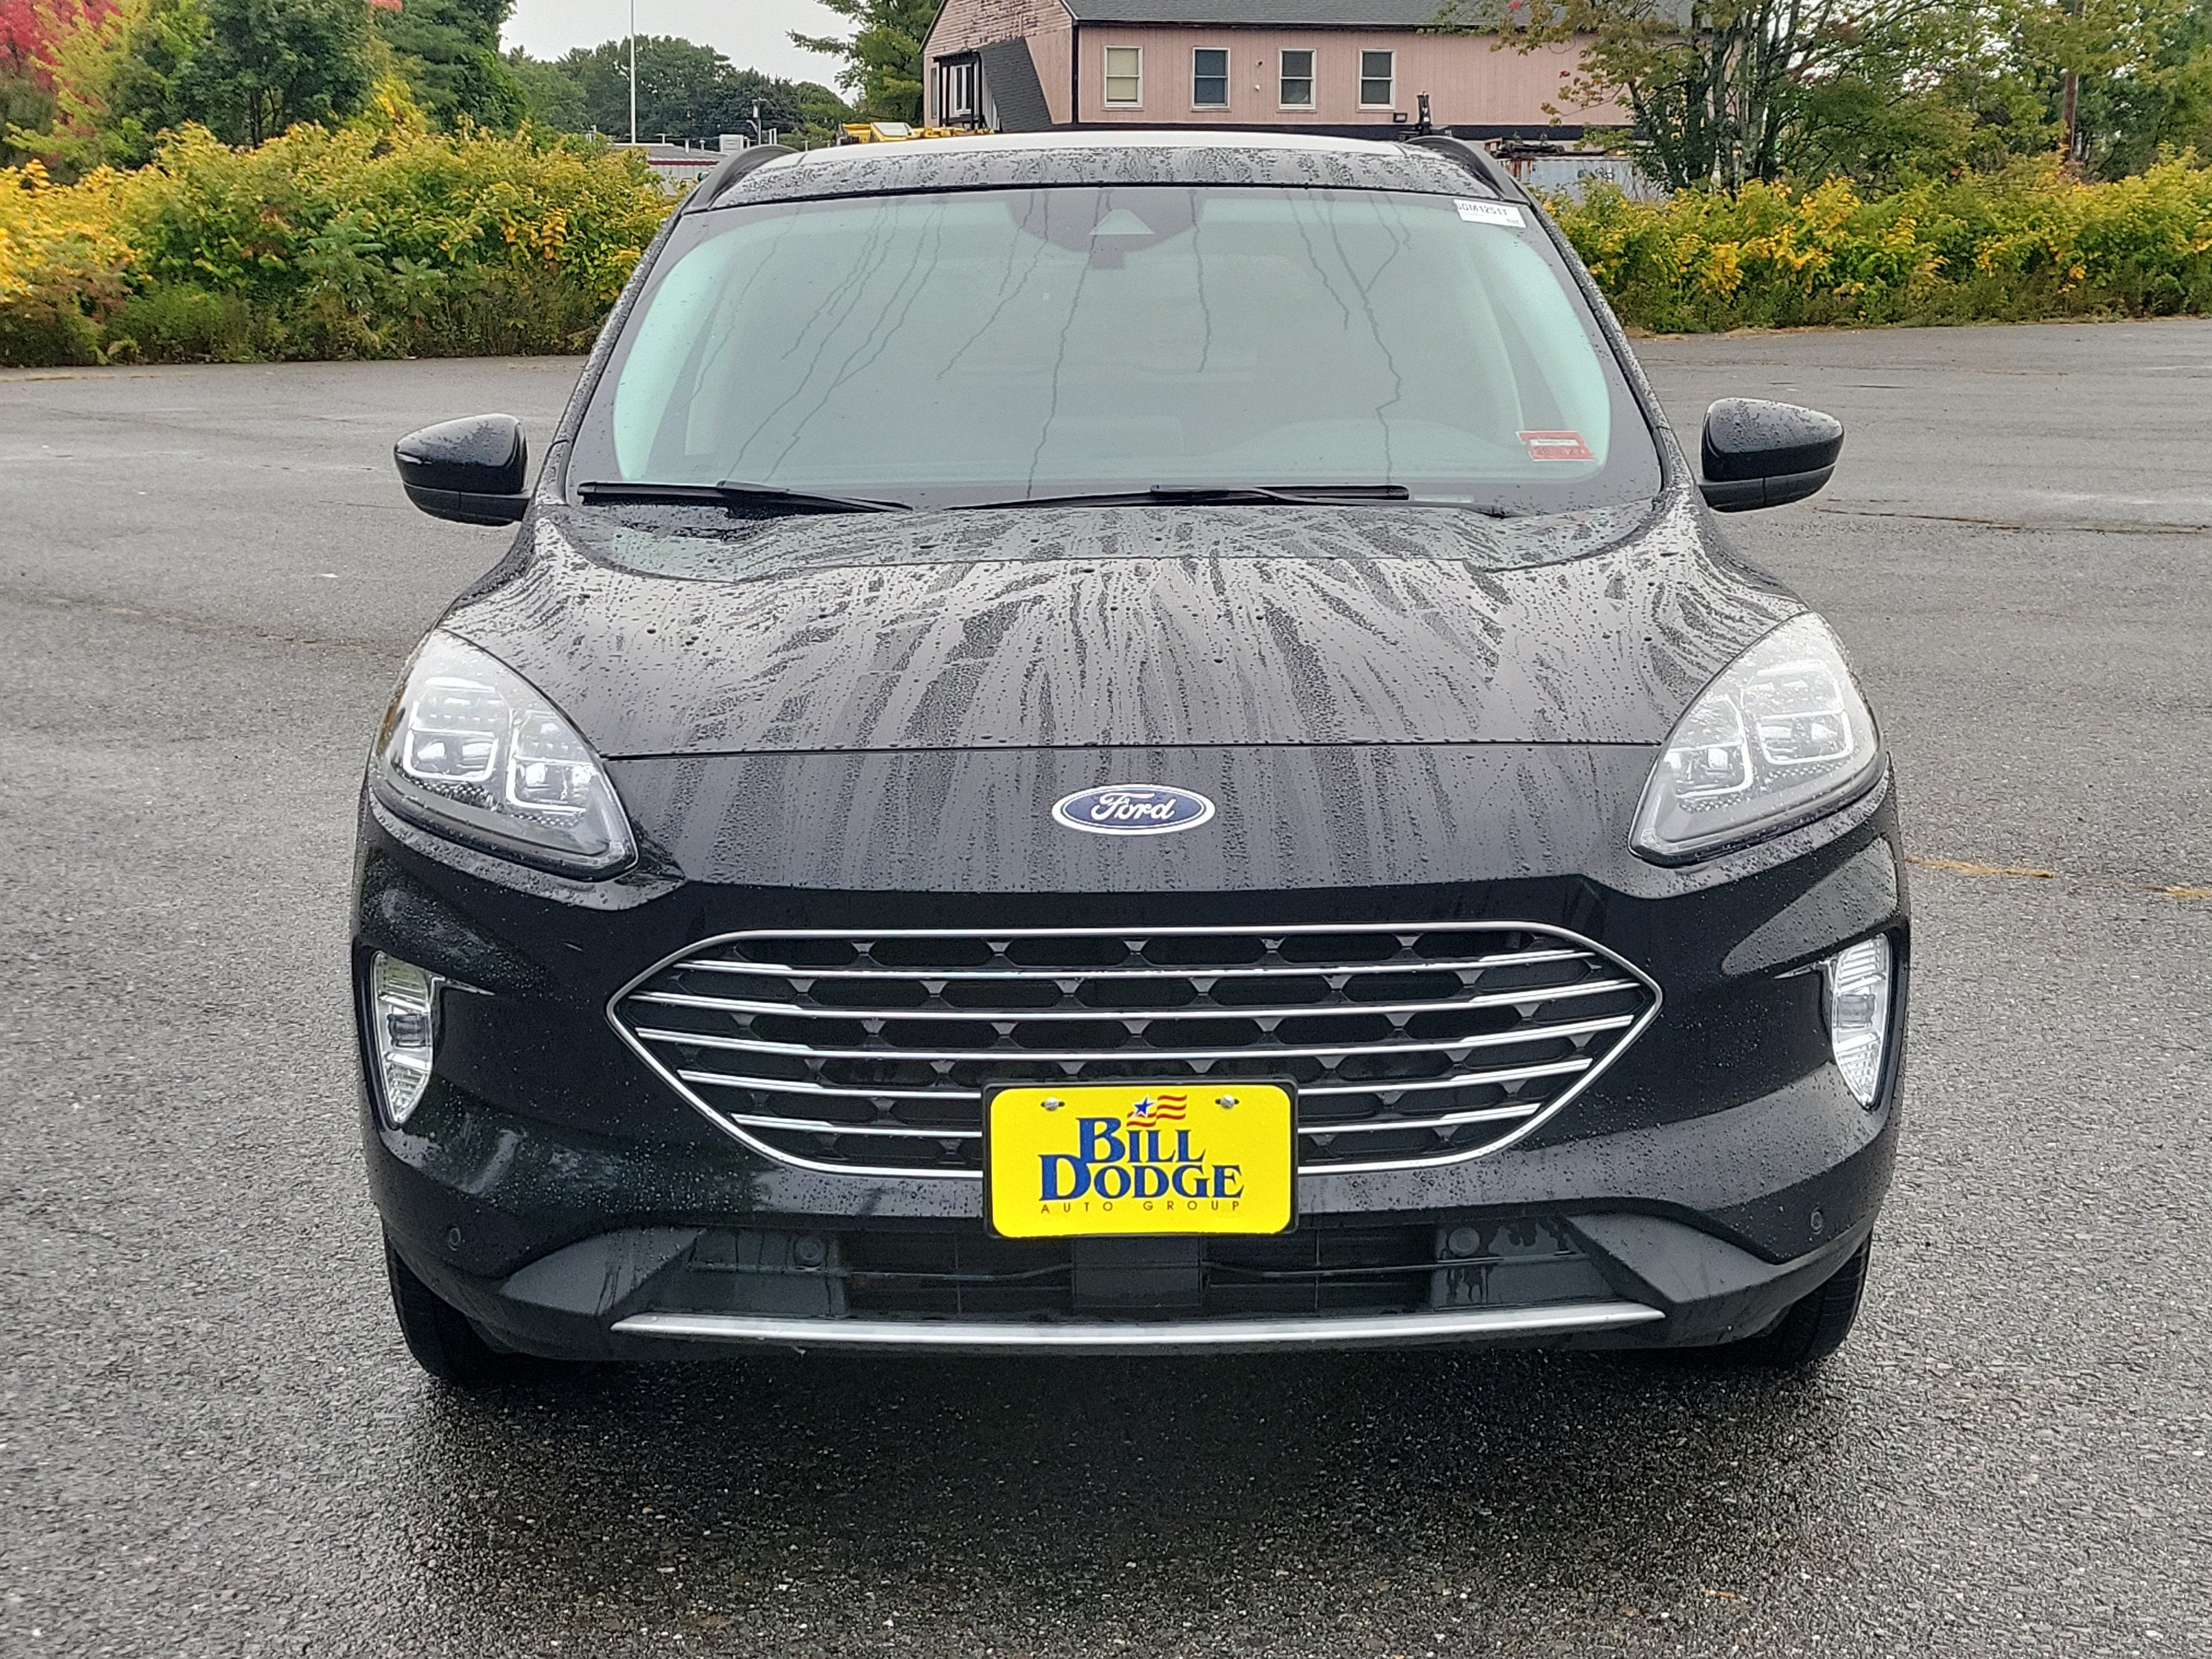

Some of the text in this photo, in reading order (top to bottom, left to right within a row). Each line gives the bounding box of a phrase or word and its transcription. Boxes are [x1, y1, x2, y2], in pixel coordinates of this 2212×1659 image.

[1090, 792, 1177, 821] Ford
[1076, 1116, 1206, 1163] BILL
[1038, 1154, 1245, 1201] DODGE
[1040, 1200, 1240, 1214] AUTO GROUP
